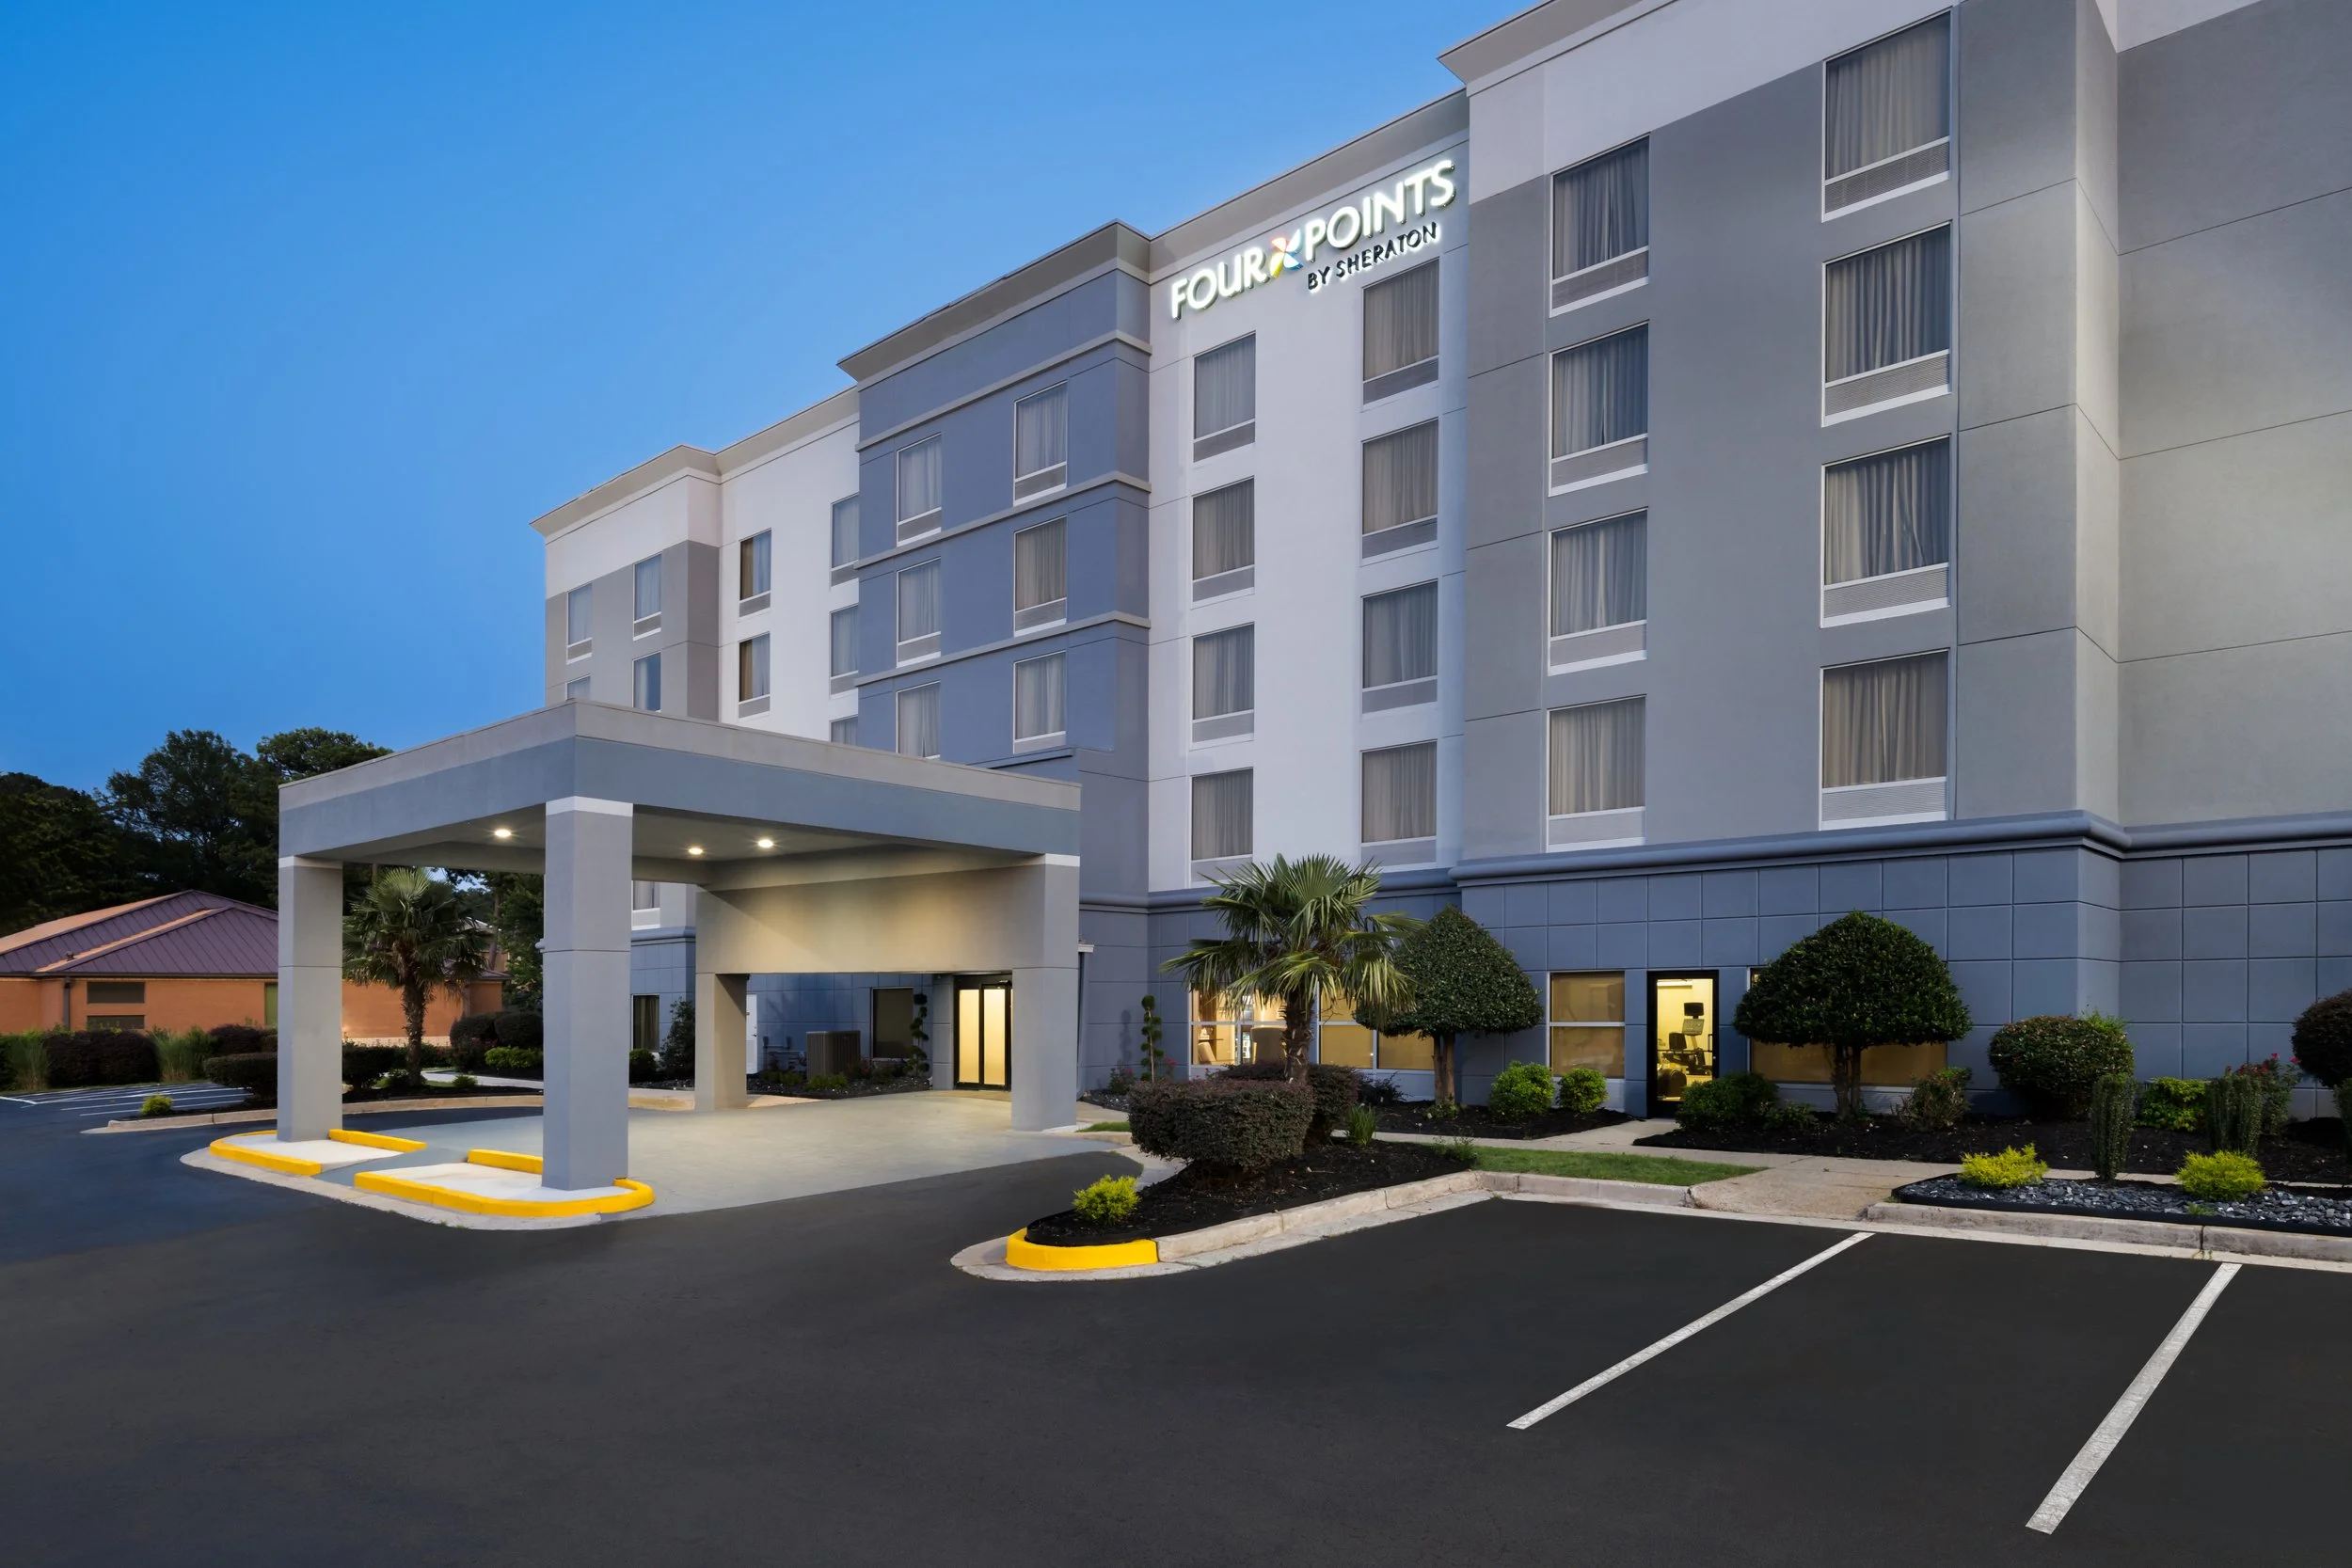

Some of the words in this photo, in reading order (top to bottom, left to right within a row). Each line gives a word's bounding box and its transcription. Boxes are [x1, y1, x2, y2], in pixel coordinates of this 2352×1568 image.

[1171, 246, 1269, 320] FOUR
[1305, 159, 1456, 262] POINTS
[1308, 266, 1330, 291] BY
[1336, 221, 1438, 279] SHERATON
